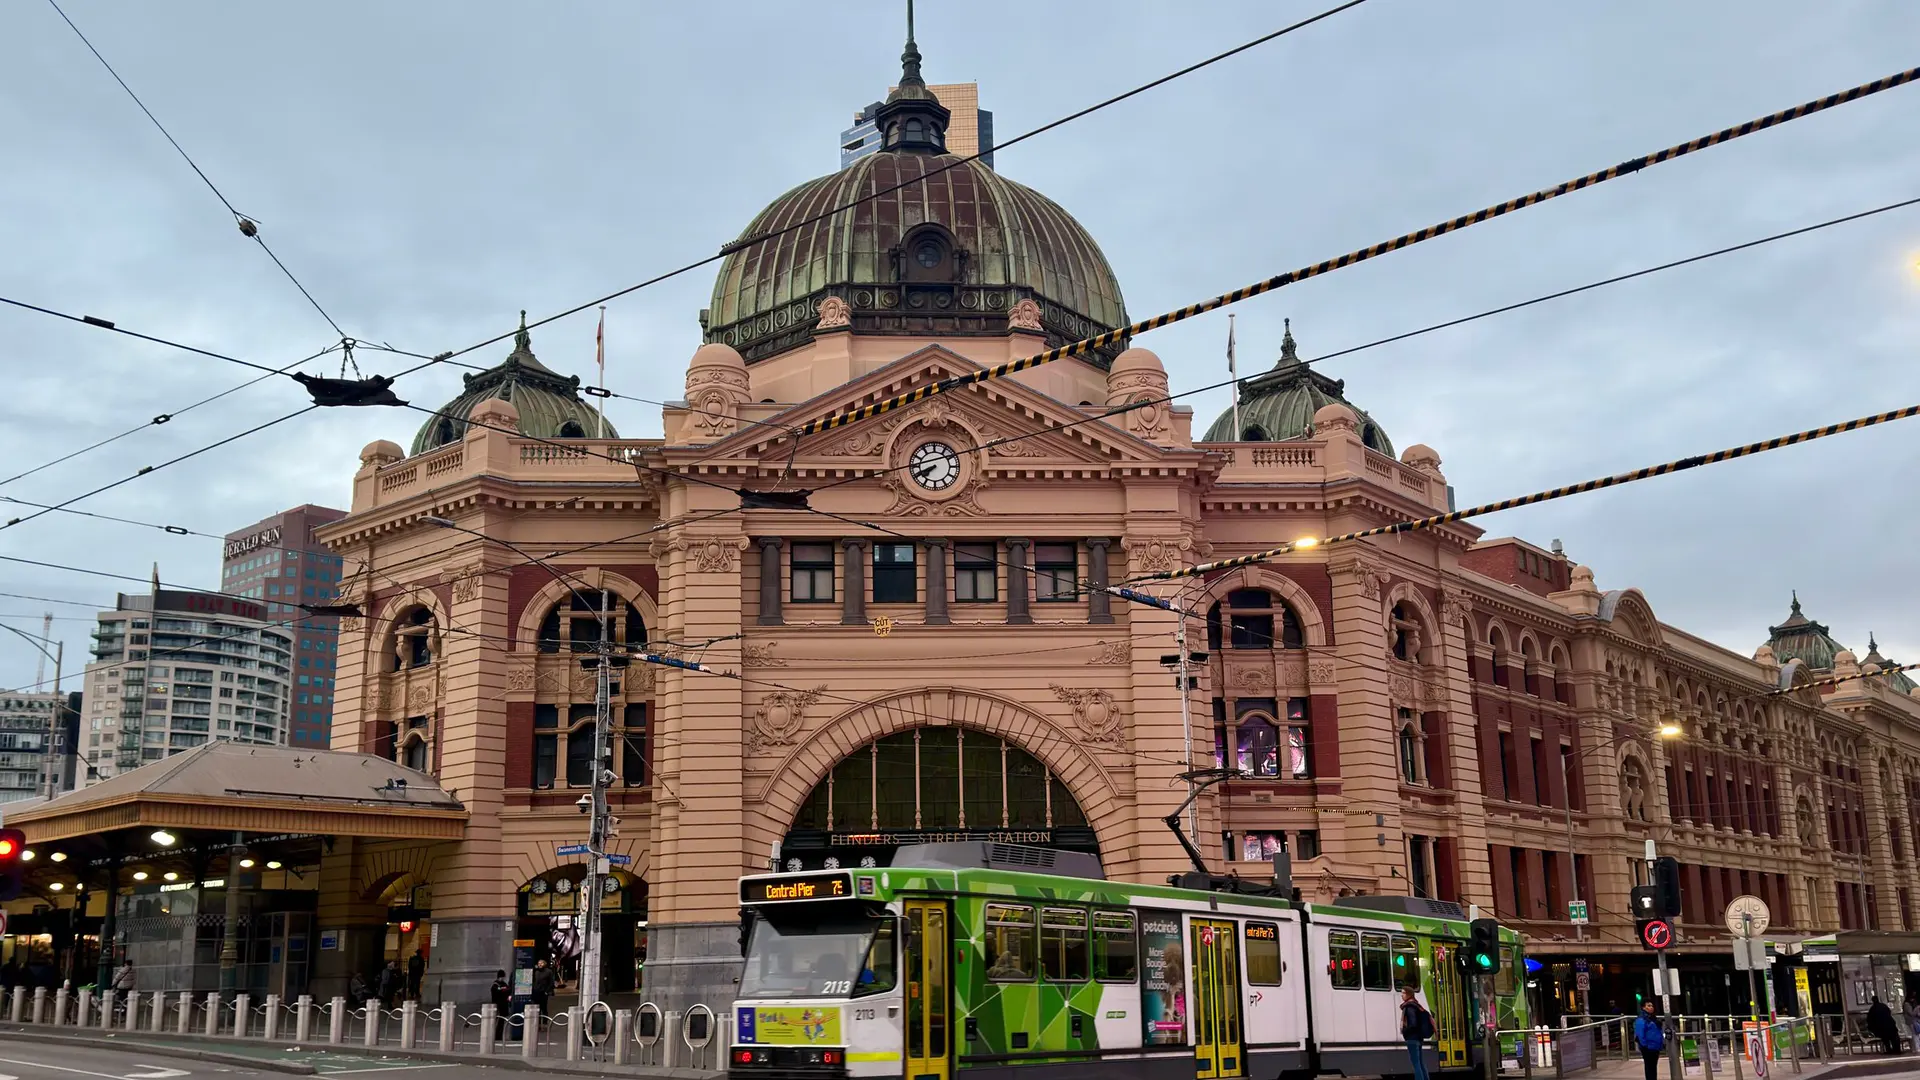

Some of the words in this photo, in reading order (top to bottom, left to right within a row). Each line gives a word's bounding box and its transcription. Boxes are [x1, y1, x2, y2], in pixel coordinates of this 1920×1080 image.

[261, 527, 280, 545] SUN
[875, 618, 888, 627] CUT
[877, 627, 890, 635] OFF
[831, 833, 900, 846] FLINDERS
[918, 832, 971, 844] STREET
[988, 831, 1051, 843] STATION
[766, 883, 797, 899] Central
[797, 882, 815, 897] Pier
[832, 880, 843, 895] 75
[1143, 920, 1178, 935] petcircle
[1148, 947, 1165, 957] More
[1151, 970, 1165, 979] Less
[821, 981, 851, 994] 2113
[855, 1009, 876, 1021] 2113
